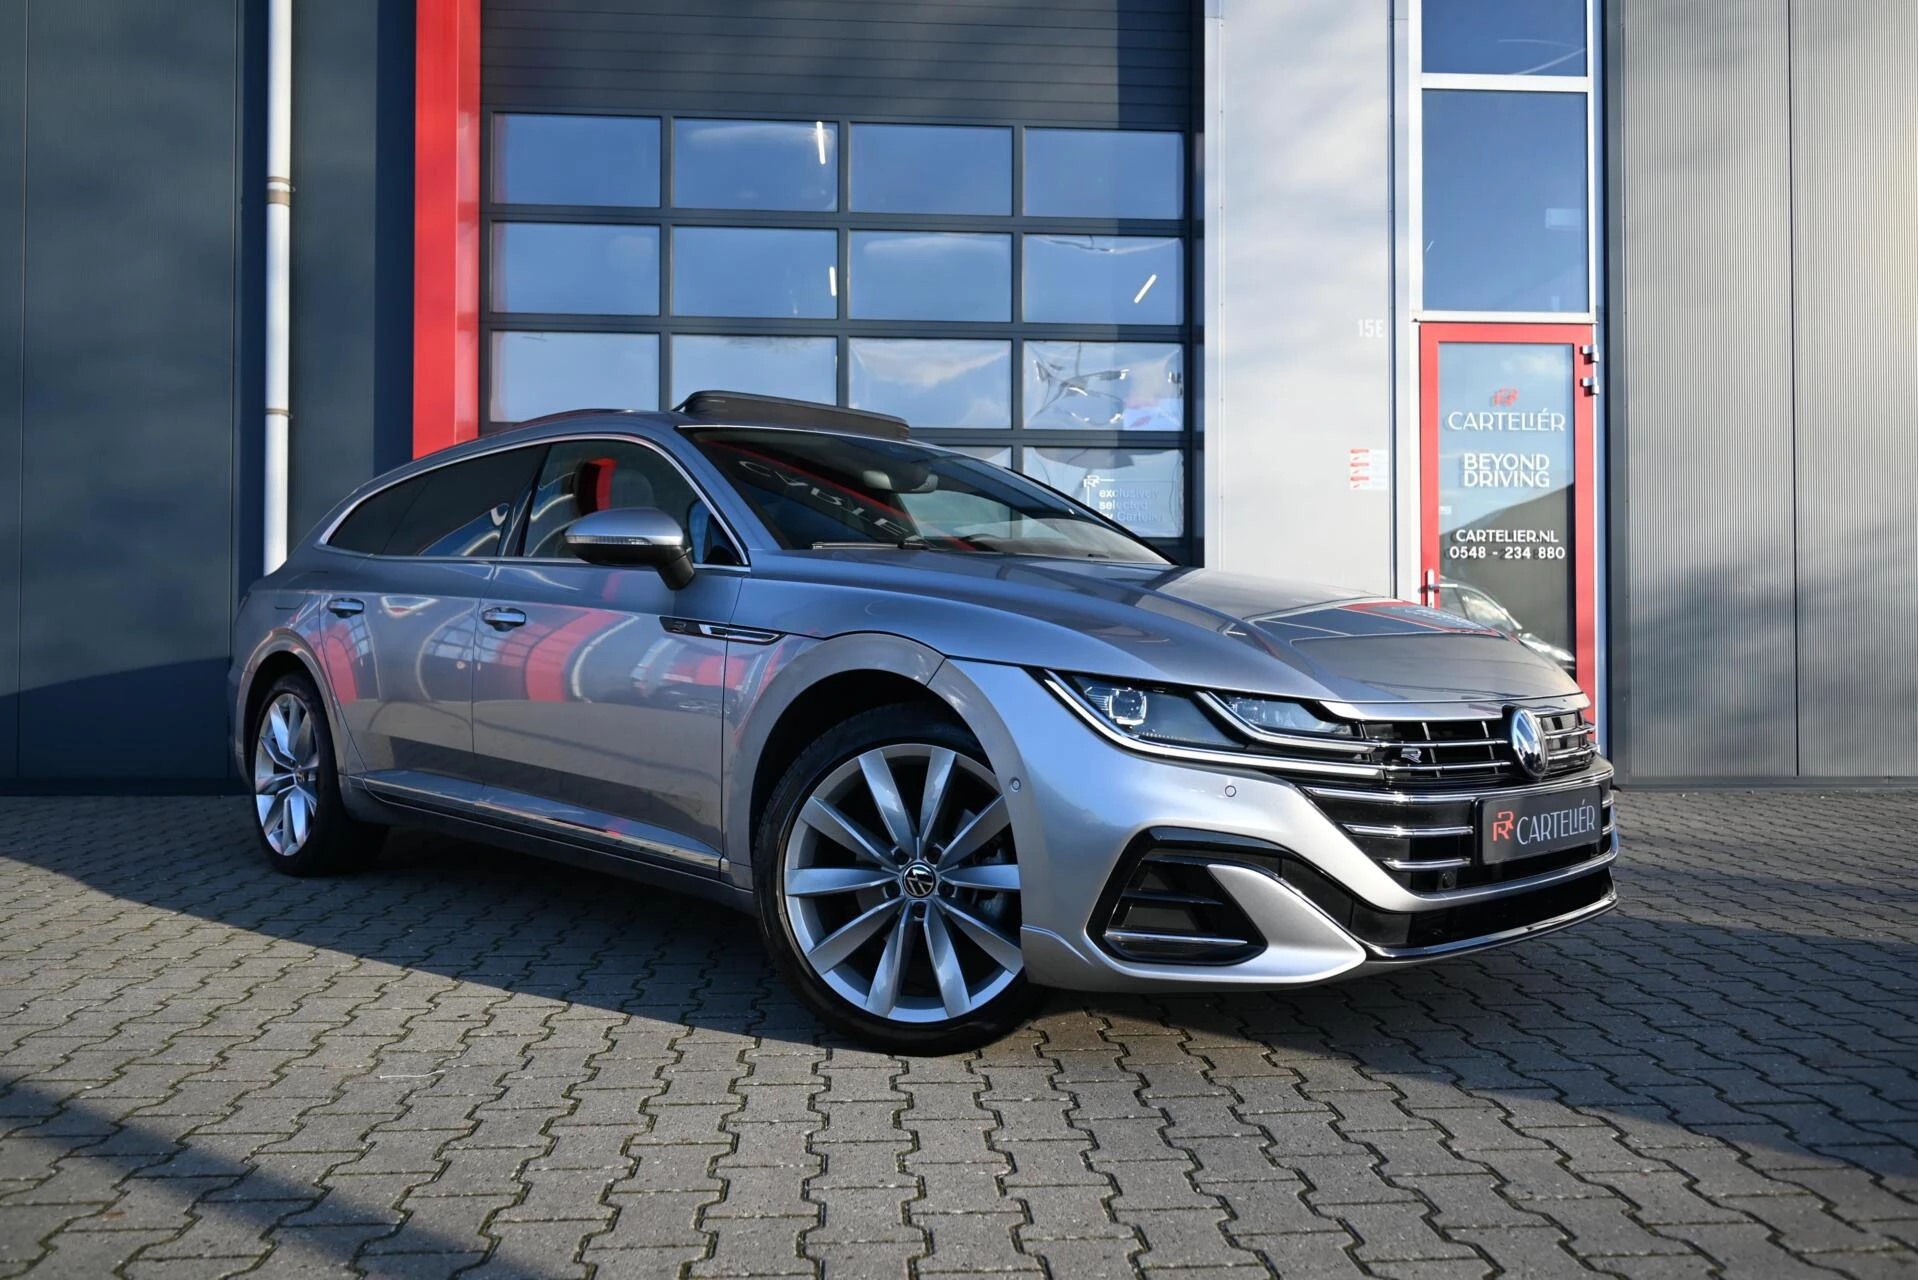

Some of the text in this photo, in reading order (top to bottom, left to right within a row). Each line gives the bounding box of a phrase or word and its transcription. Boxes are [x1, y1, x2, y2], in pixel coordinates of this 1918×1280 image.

[1357, 319, 1385, 338] 15E
[1463, 453, 1550, 470] BEYOND
[1463, 470, 1550, 488] DRIVING
[1455, 529, 1559, 543] CARTELIER.NL
[1449, 546, 1487, 560] 0548
[1504, 546, 1531, 560] 234
[1538, 546, 1566, 560] 880
